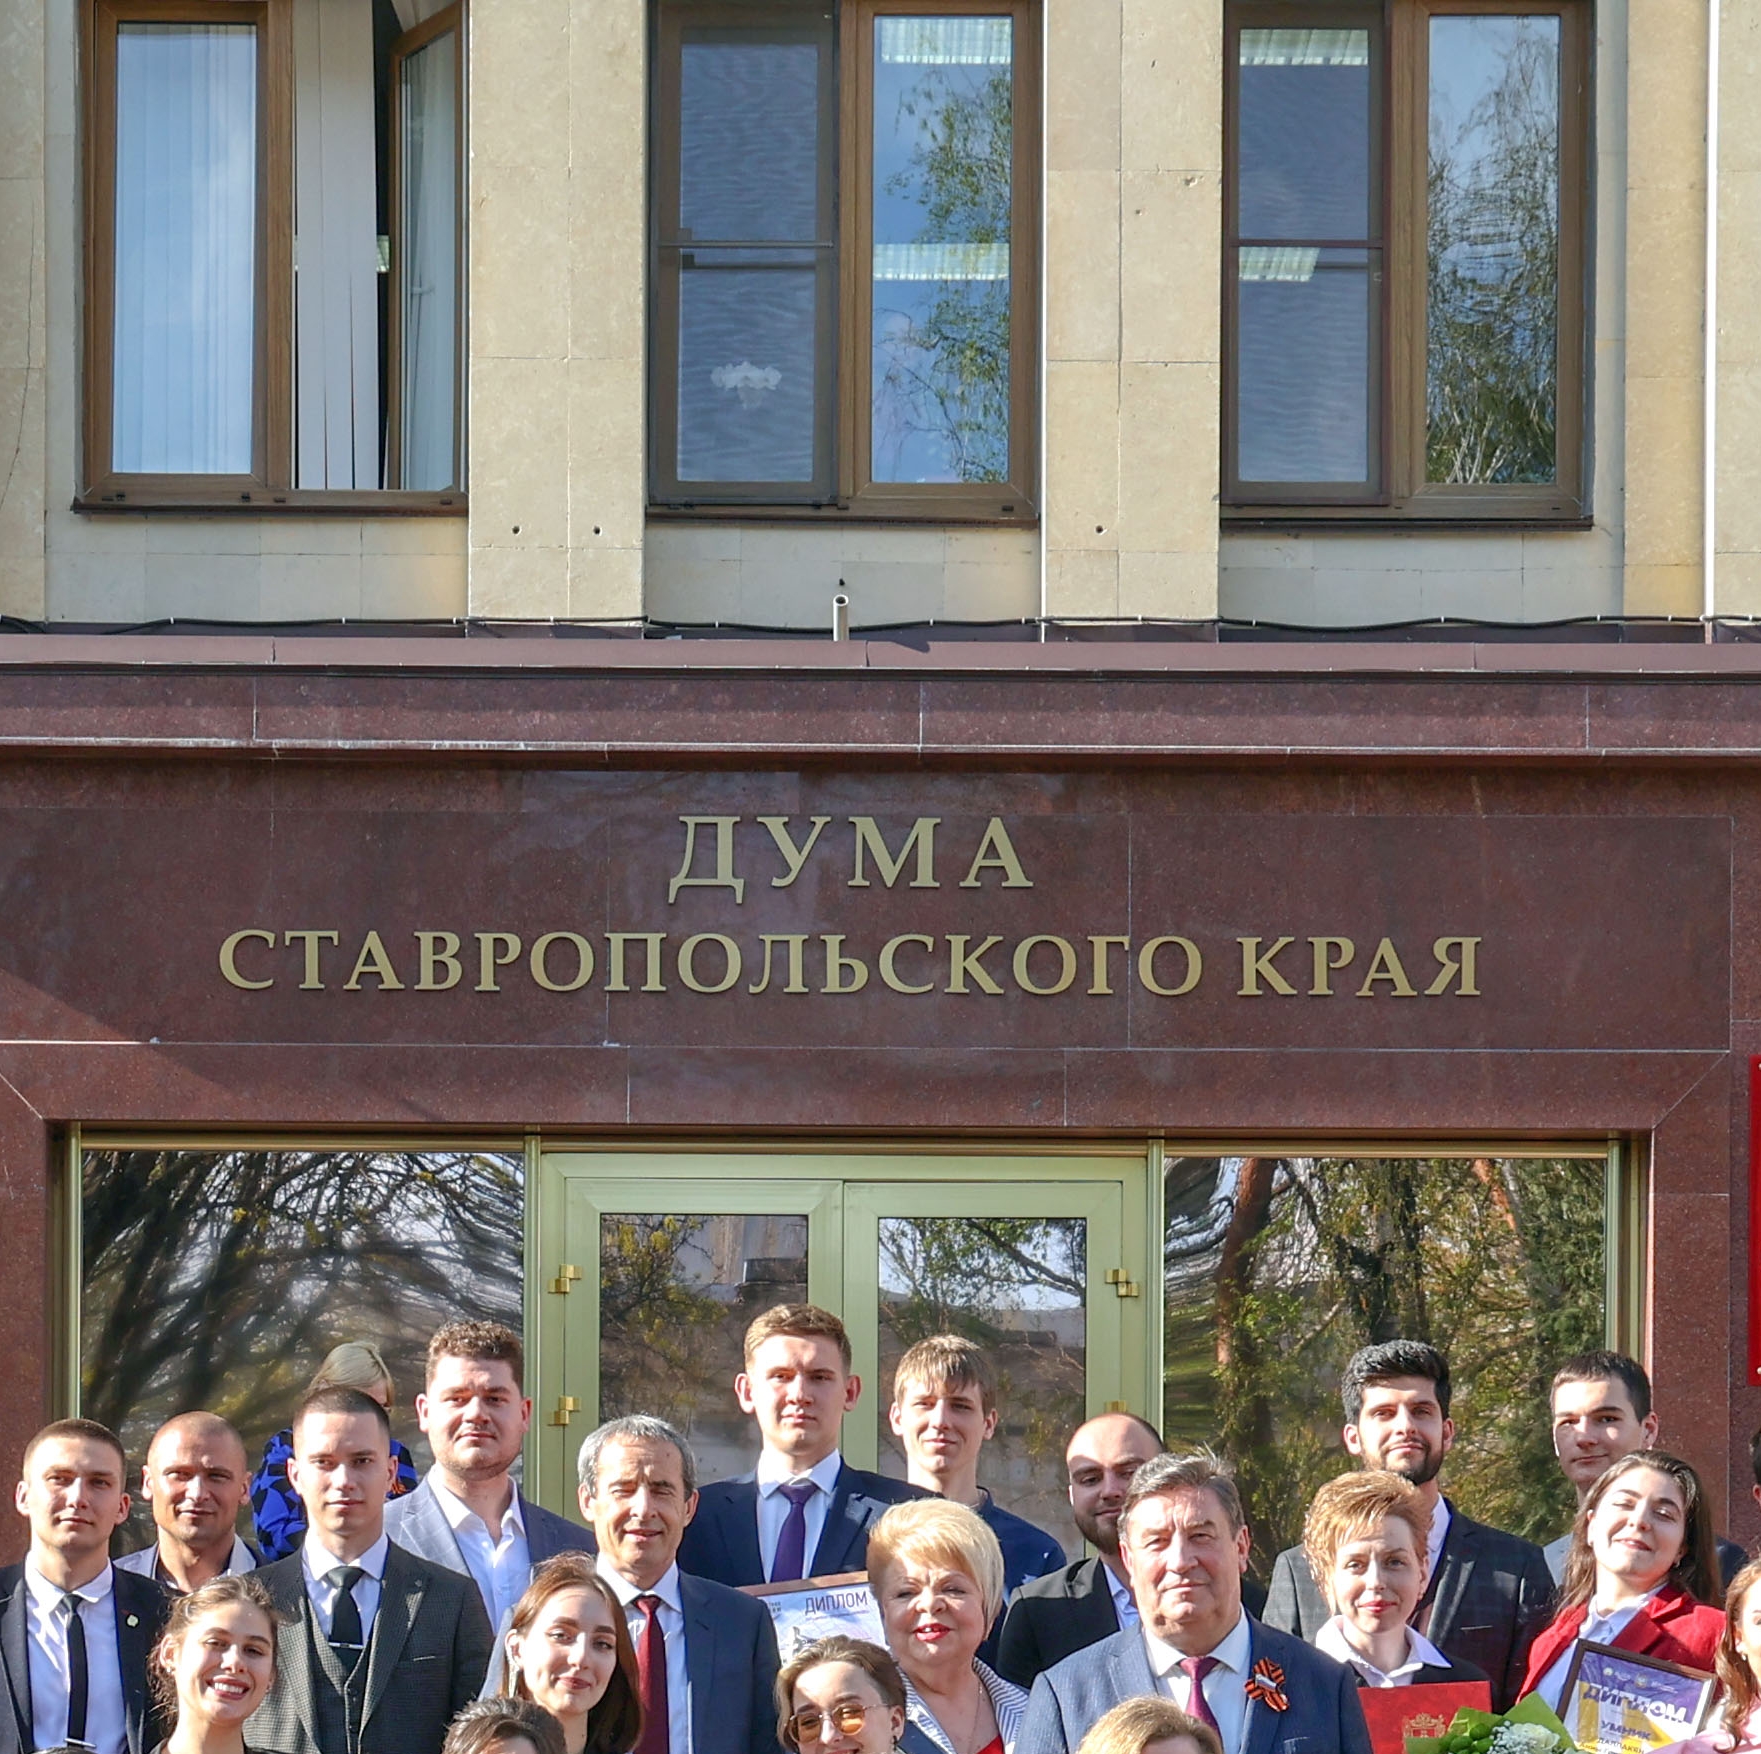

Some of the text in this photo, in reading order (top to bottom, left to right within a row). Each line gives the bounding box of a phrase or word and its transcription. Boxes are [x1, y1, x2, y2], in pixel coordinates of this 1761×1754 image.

[668, 815, 1034, 903] ДУМА
[219, 929, 1482, 998] СТАВРОПОЛЬСКОГО КРАЯ
[805, 1591, 868, 1616] ДИПЛОМ
[1583, 1682, 1687, 1724] ДИПЛОМ
[1601, 1720, 1652, 1740] УМНИК
